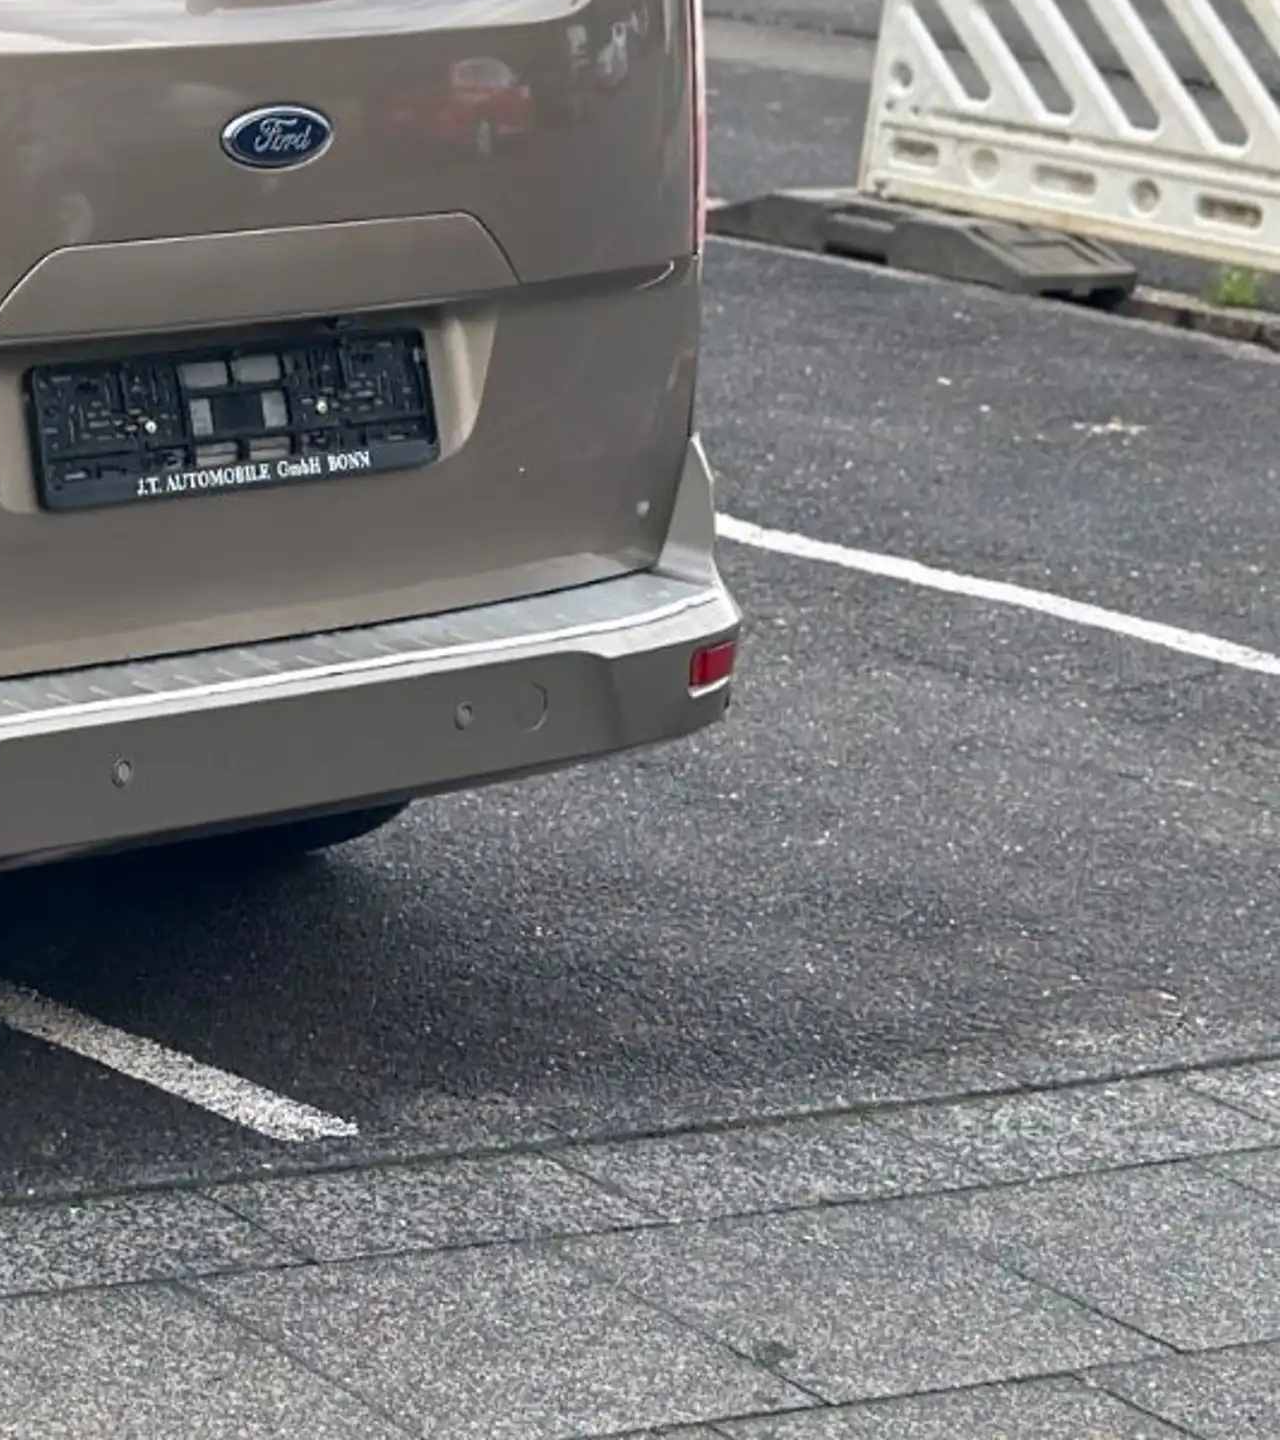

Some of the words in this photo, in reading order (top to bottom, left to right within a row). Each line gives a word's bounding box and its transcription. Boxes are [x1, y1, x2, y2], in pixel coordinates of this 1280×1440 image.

[254, 117, 312, 152] Ford
[137, 476, 162, 496] J.T.
[166, 463, 271, 491] AUTOMOBILE
[277, 458, 322, 478] GmbH
[328, 450, 370, 472] BONN
